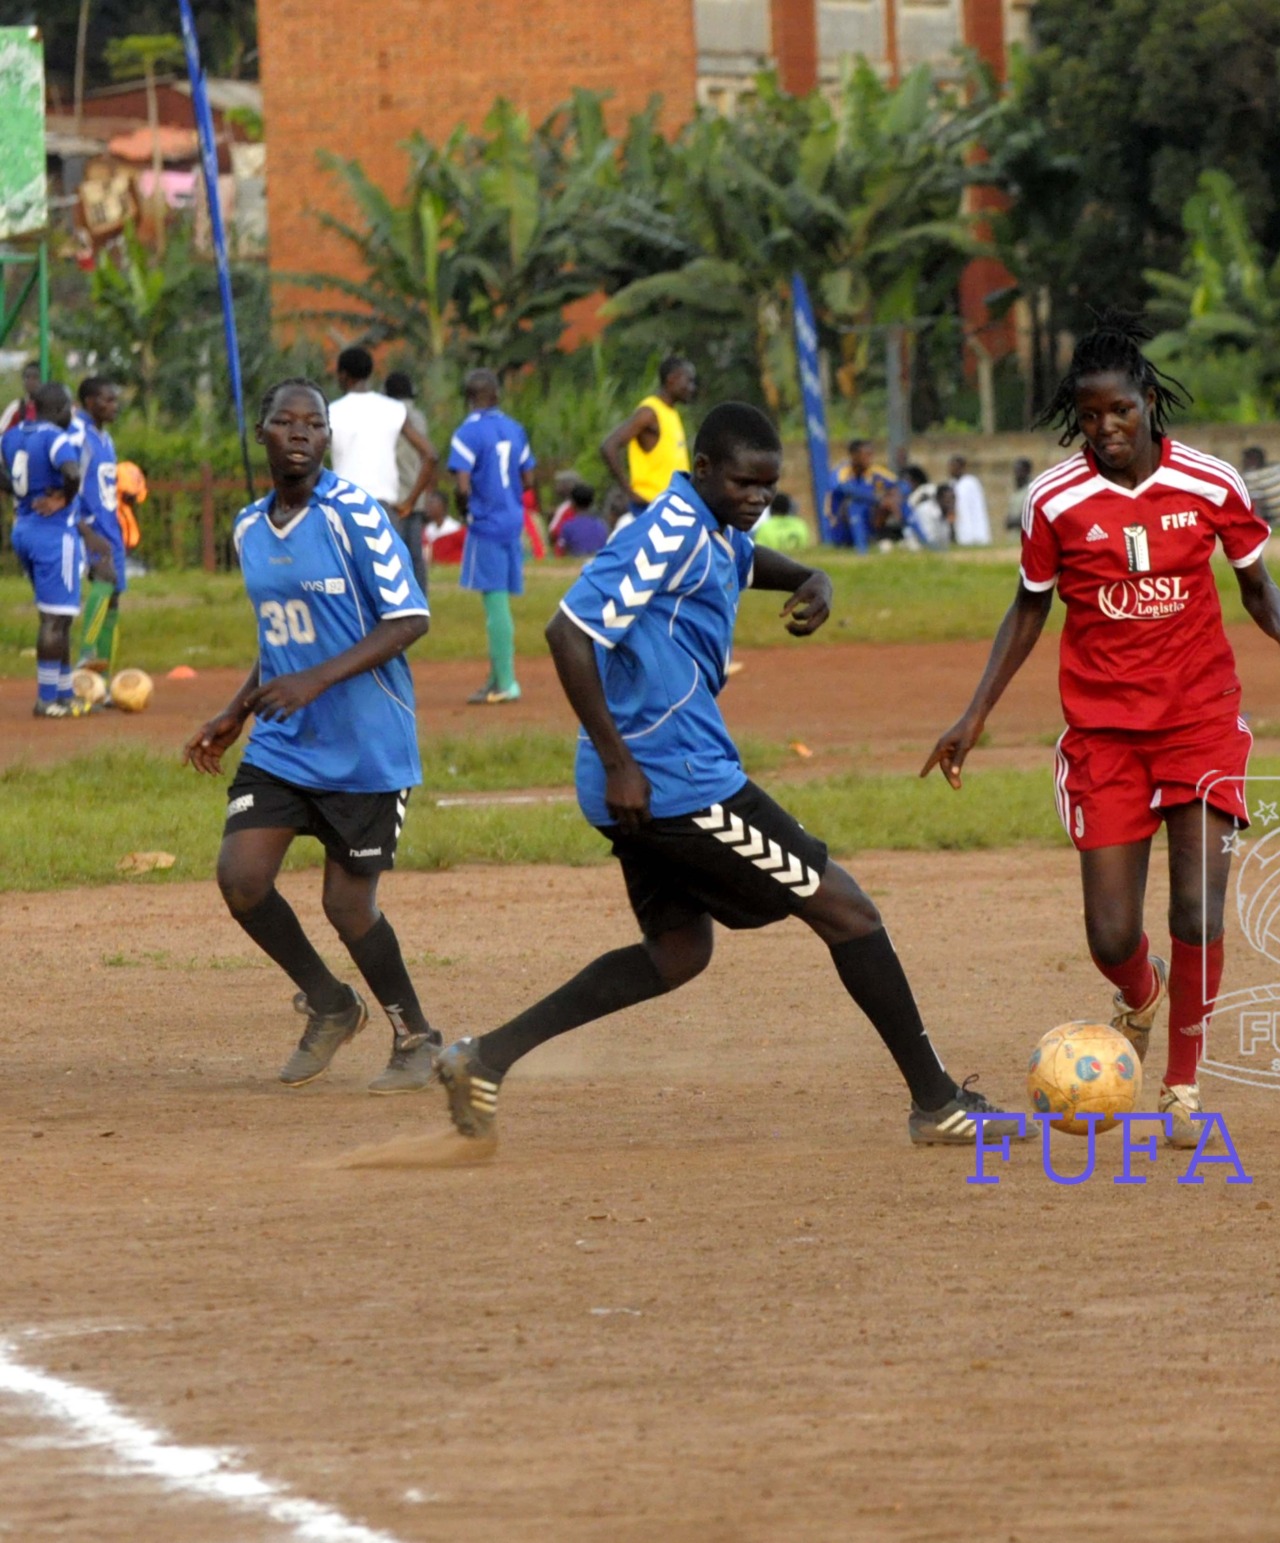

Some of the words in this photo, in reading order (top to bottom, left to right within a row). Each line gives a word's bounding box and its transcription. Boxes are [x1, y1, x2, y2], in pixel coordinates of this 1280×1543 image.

[495, 440, 511, 489] 1
[1161, 511, 1199, 531] FIFA
[301, 580, 325, 593] VVS
[1138, 577, 1190, 601] SSL
[260, 599, 316, 647] 30
[1075, 805, 1085, 838] 9
